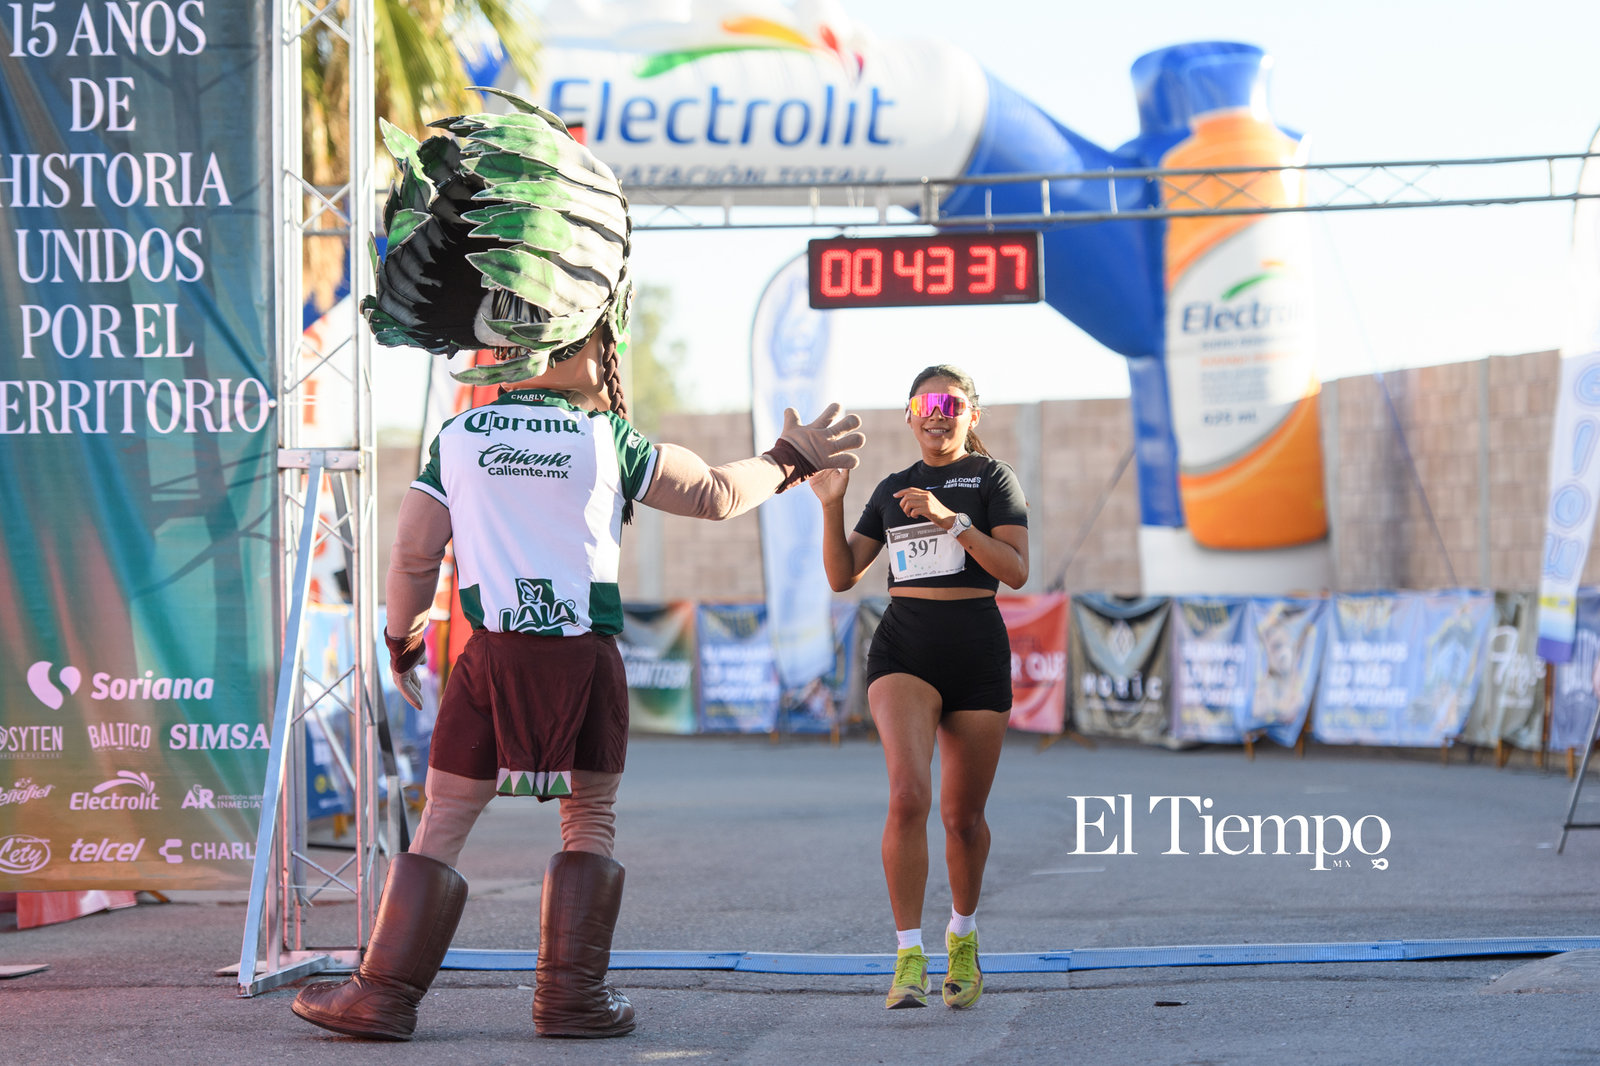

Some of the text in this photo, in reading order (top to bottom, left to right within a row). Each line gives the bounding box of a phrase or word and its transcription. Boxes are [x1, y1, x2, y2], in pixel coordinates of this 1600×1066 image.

[9, 2, 57, 57] 15
[69, 77, 136, 132] DE
[549, 79, 895, 146] Electrolit
[0, 152, 232, 207] HISTORIA
[15, 228, 205, 284] UNIDOS
[821, 244, 1027, 297] 00 43 37
[20, 303, 194, 359] POR EL
[510, 393, 546, 401] CHARLY
[464, 410, 581, 436] Corona
[478, 443, 571, 468] Caliente
[487, 465, 569, 479] caliente.mx
[908, 538, 938, 558] 397
[91, 670, 214, 700] Soriana
[88, 722, 151, 750] BALTICO
[169, 723, 271, 750] SIMSA
[69, 791, 160, 810] Electrolit
[69, 838, 145, 862] telcel
[191, 842, 257, 860] CHARL
